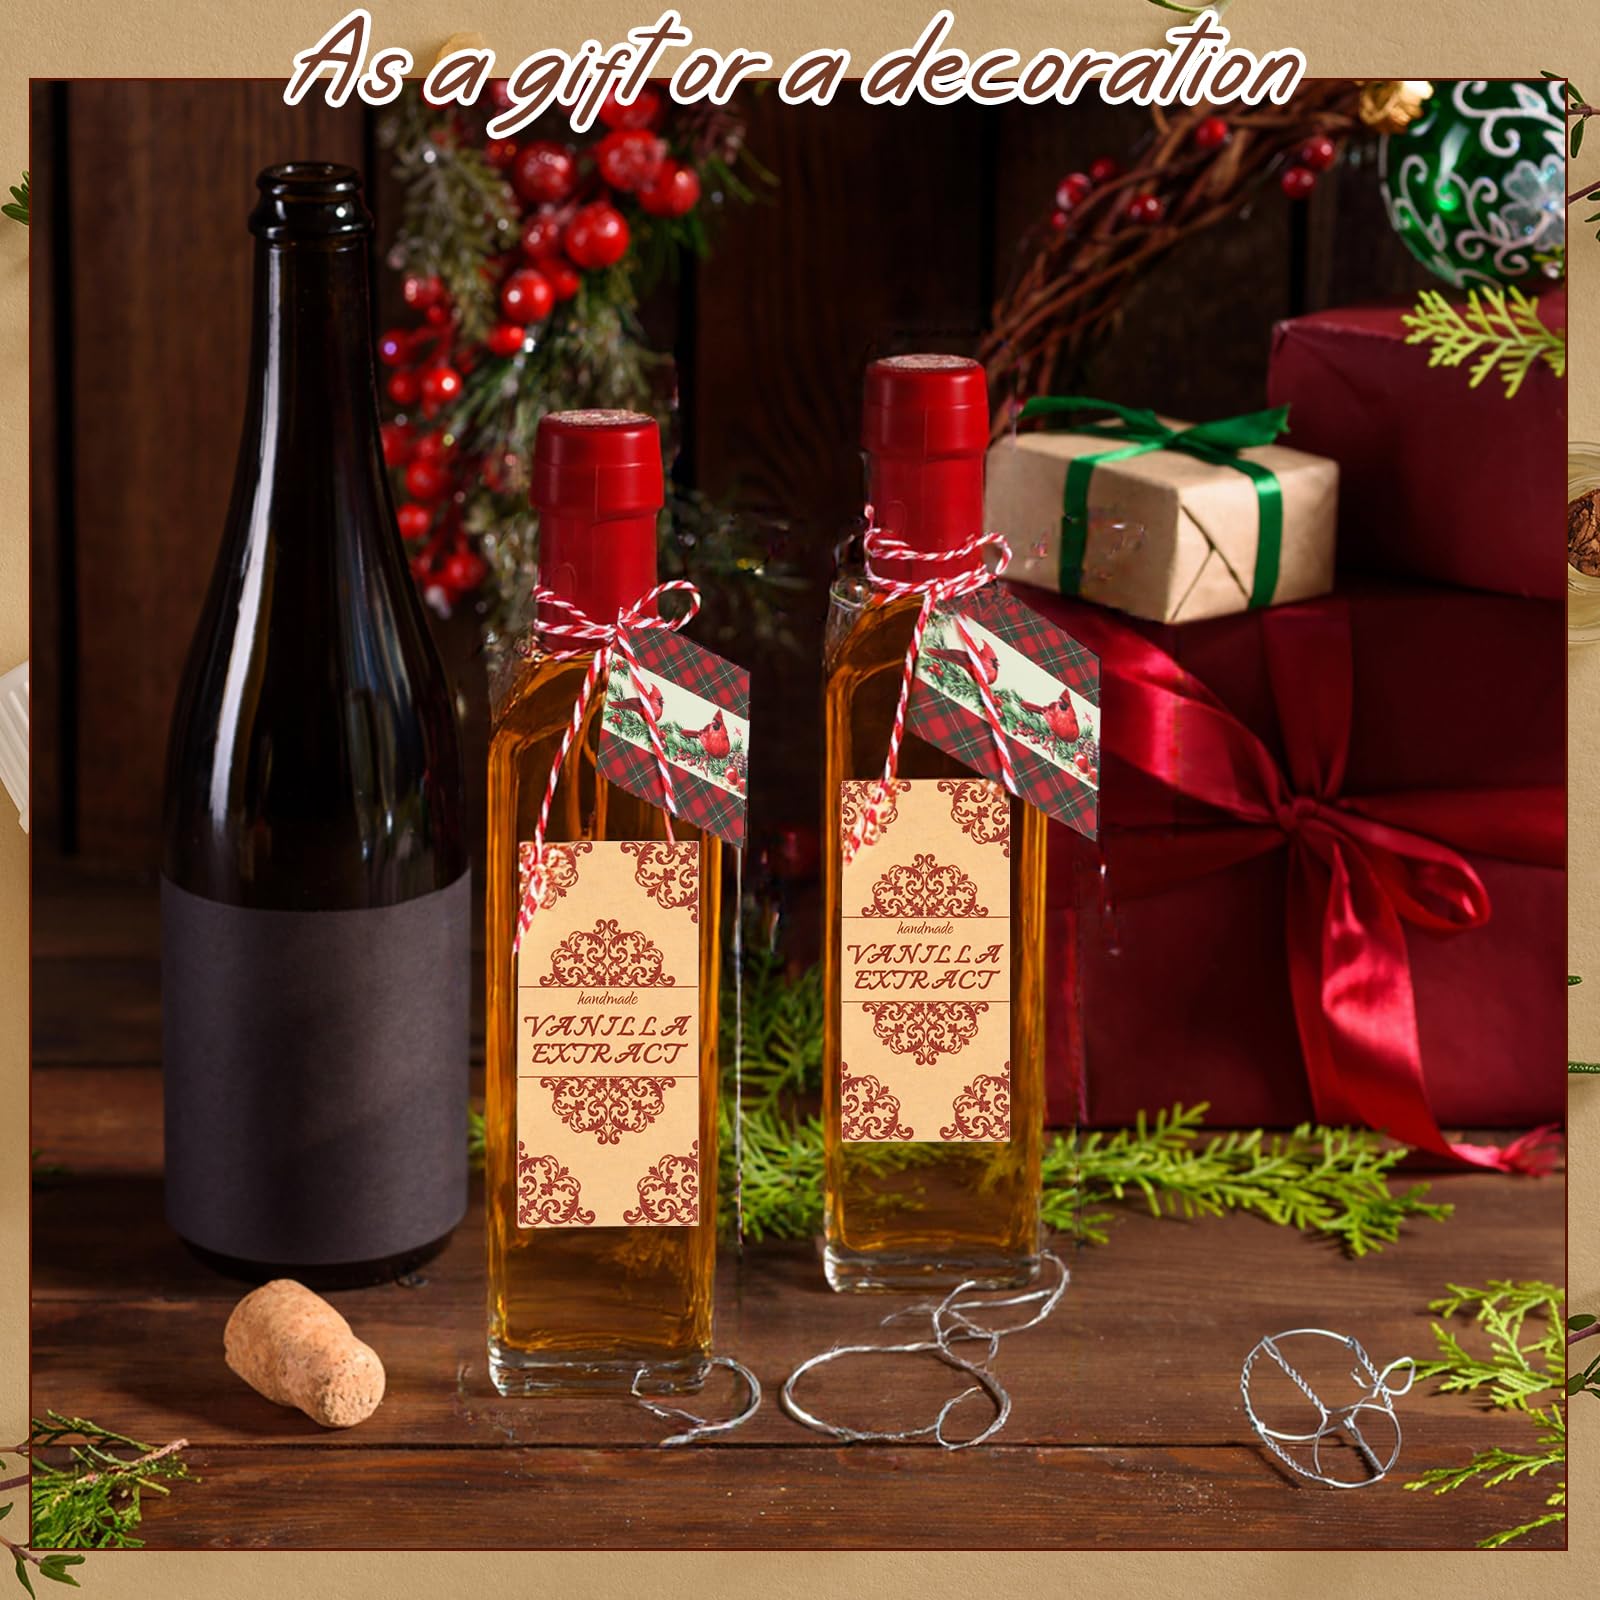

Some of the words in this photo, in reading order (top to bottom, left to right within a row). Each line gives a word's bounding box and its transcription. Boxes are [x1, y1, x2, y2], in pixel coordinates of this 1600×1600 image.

[897, 921, 954, 935] handmade
[846, 943, 1005, 965] VANILLA
[854, 969, 1001, 991] EXTRACT
[577, 991, 639, 1006] handmade
[523, 1014, 693, 1038] VANILLA
[531, 1042, 689, 1065] EXTRACT
